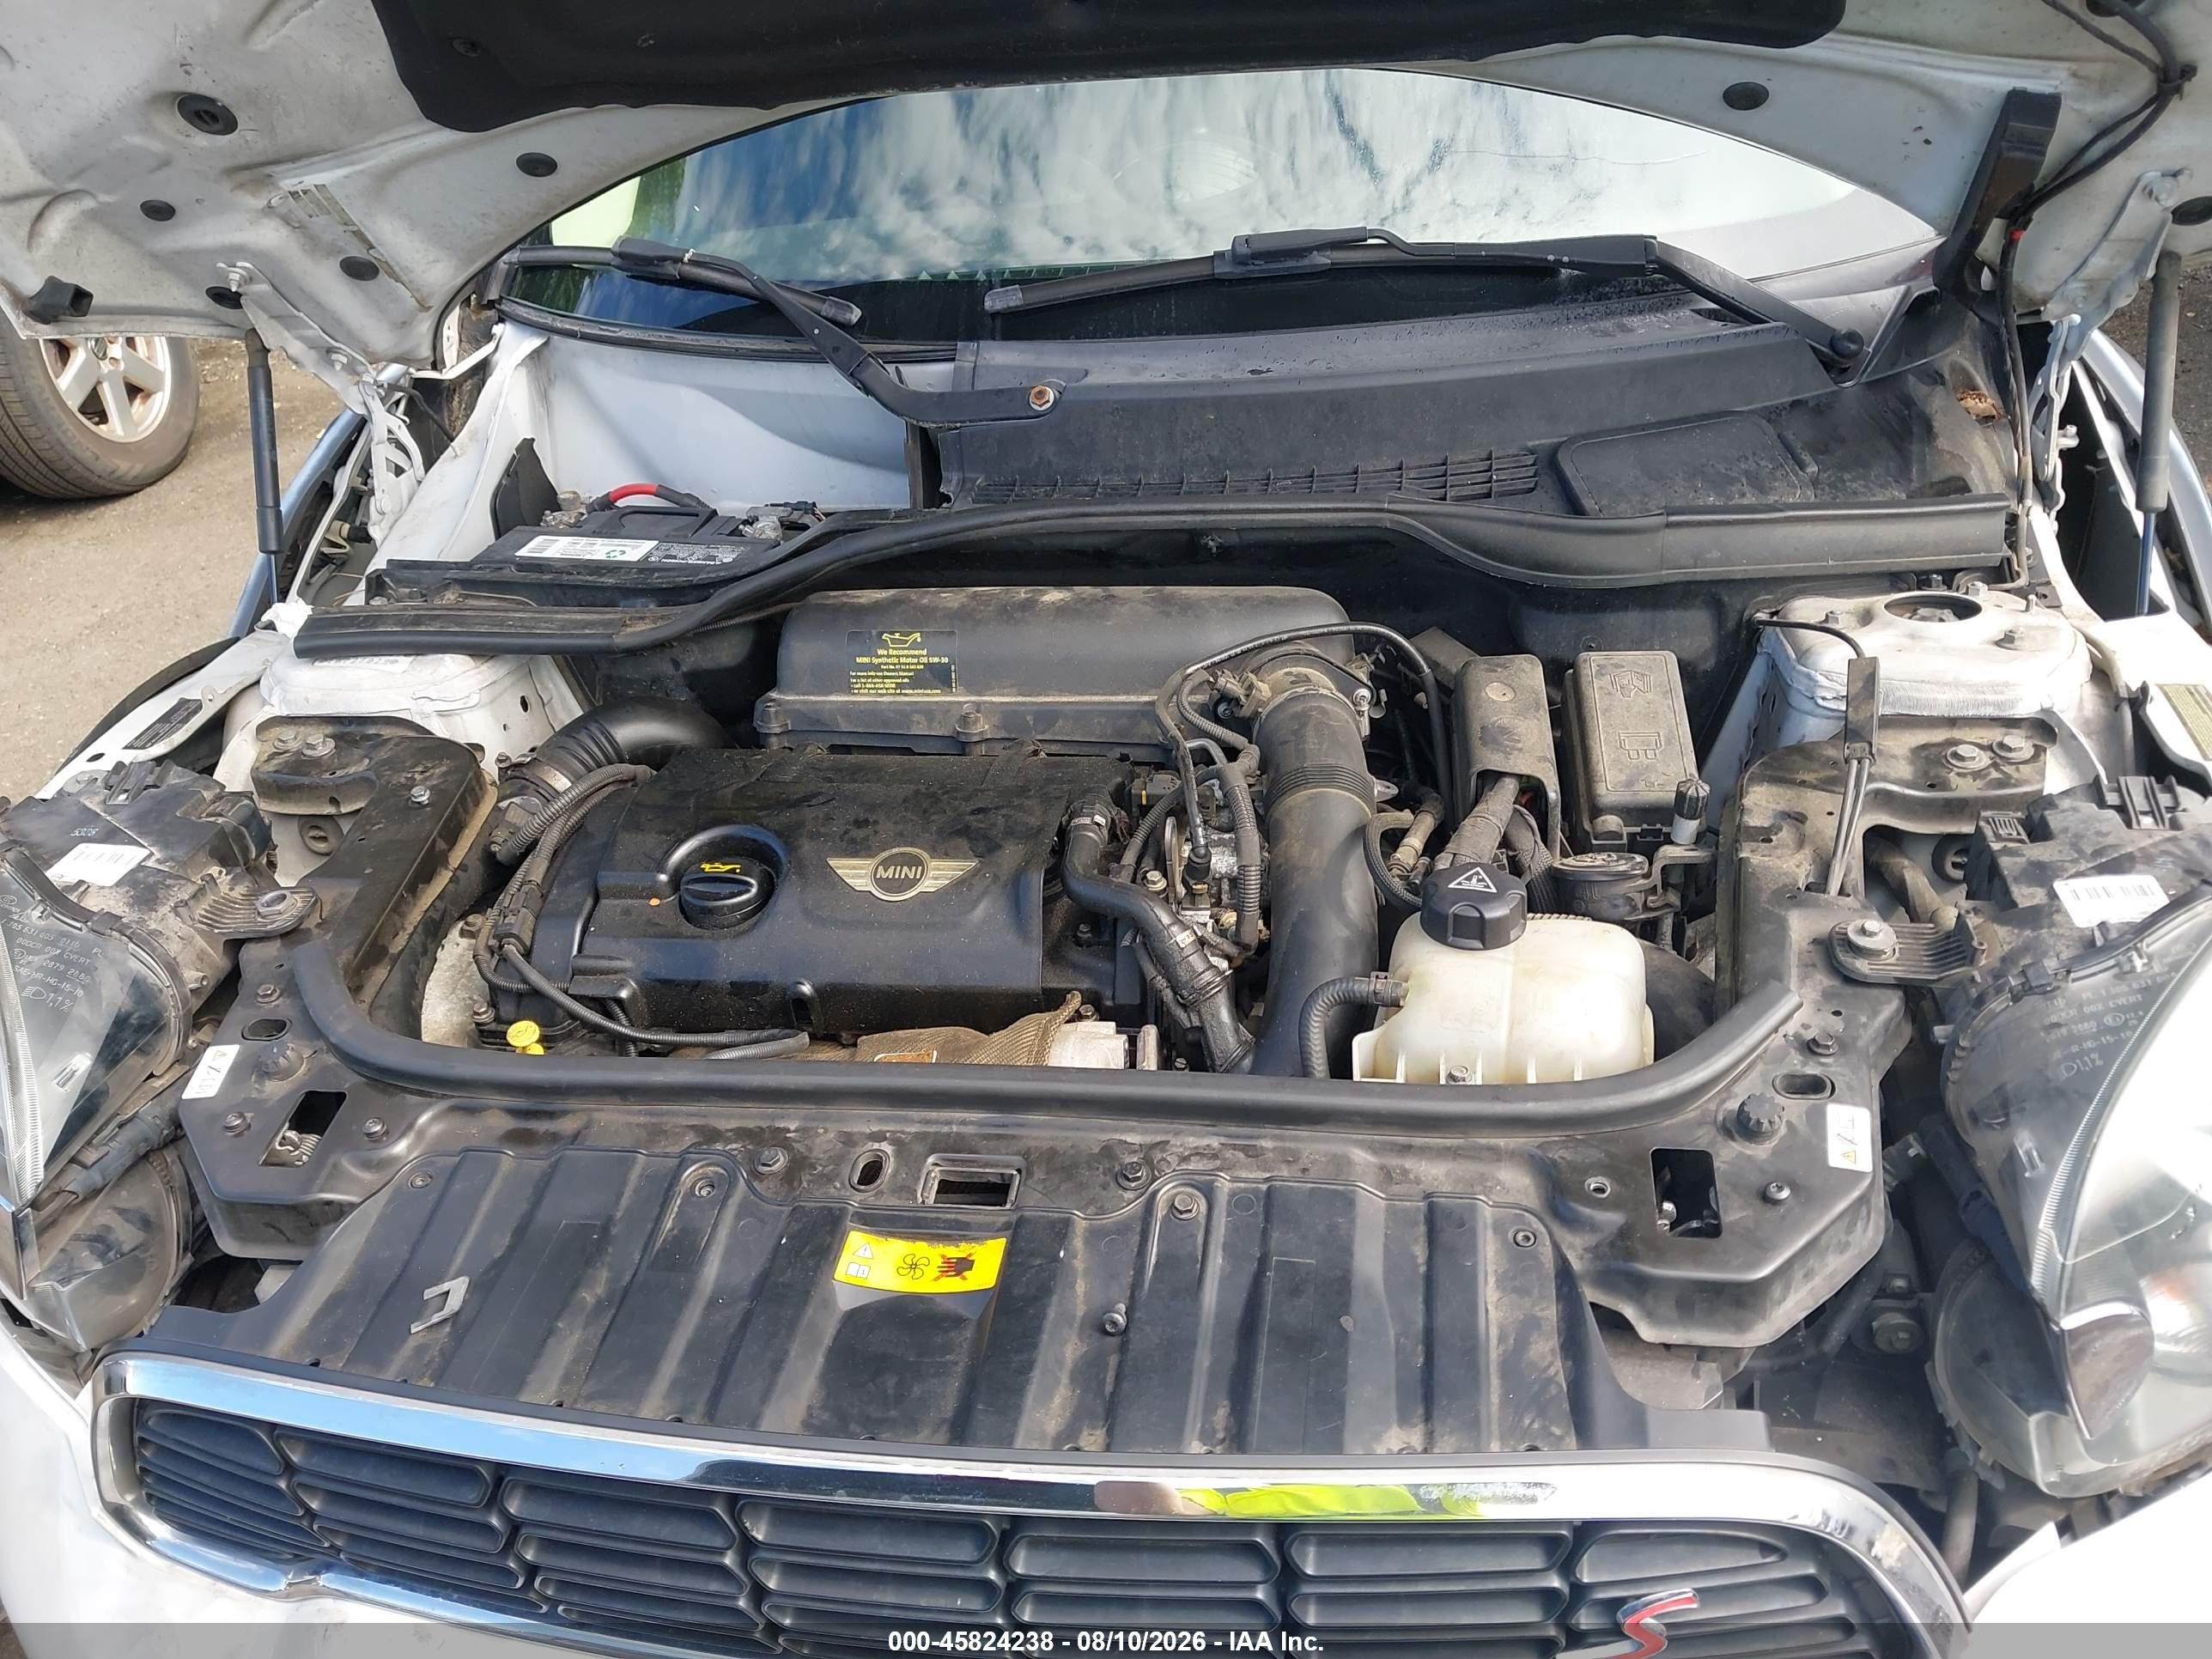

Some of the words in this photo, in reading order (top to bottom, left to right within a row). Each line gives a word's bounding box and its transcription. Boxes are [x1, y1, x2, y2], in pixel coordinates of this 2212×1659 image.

[872, 656, 899, 665] Synthetic
[876, 865, 922, 879] MINI
[22, 926, 39, 936] 631
[63, 951, 92, 965] CVERT
[43, 959, 65, 972] 2879
[46, 993, 75, 1013] 1,1%
[1556, 1588, 1699, 1659] S
